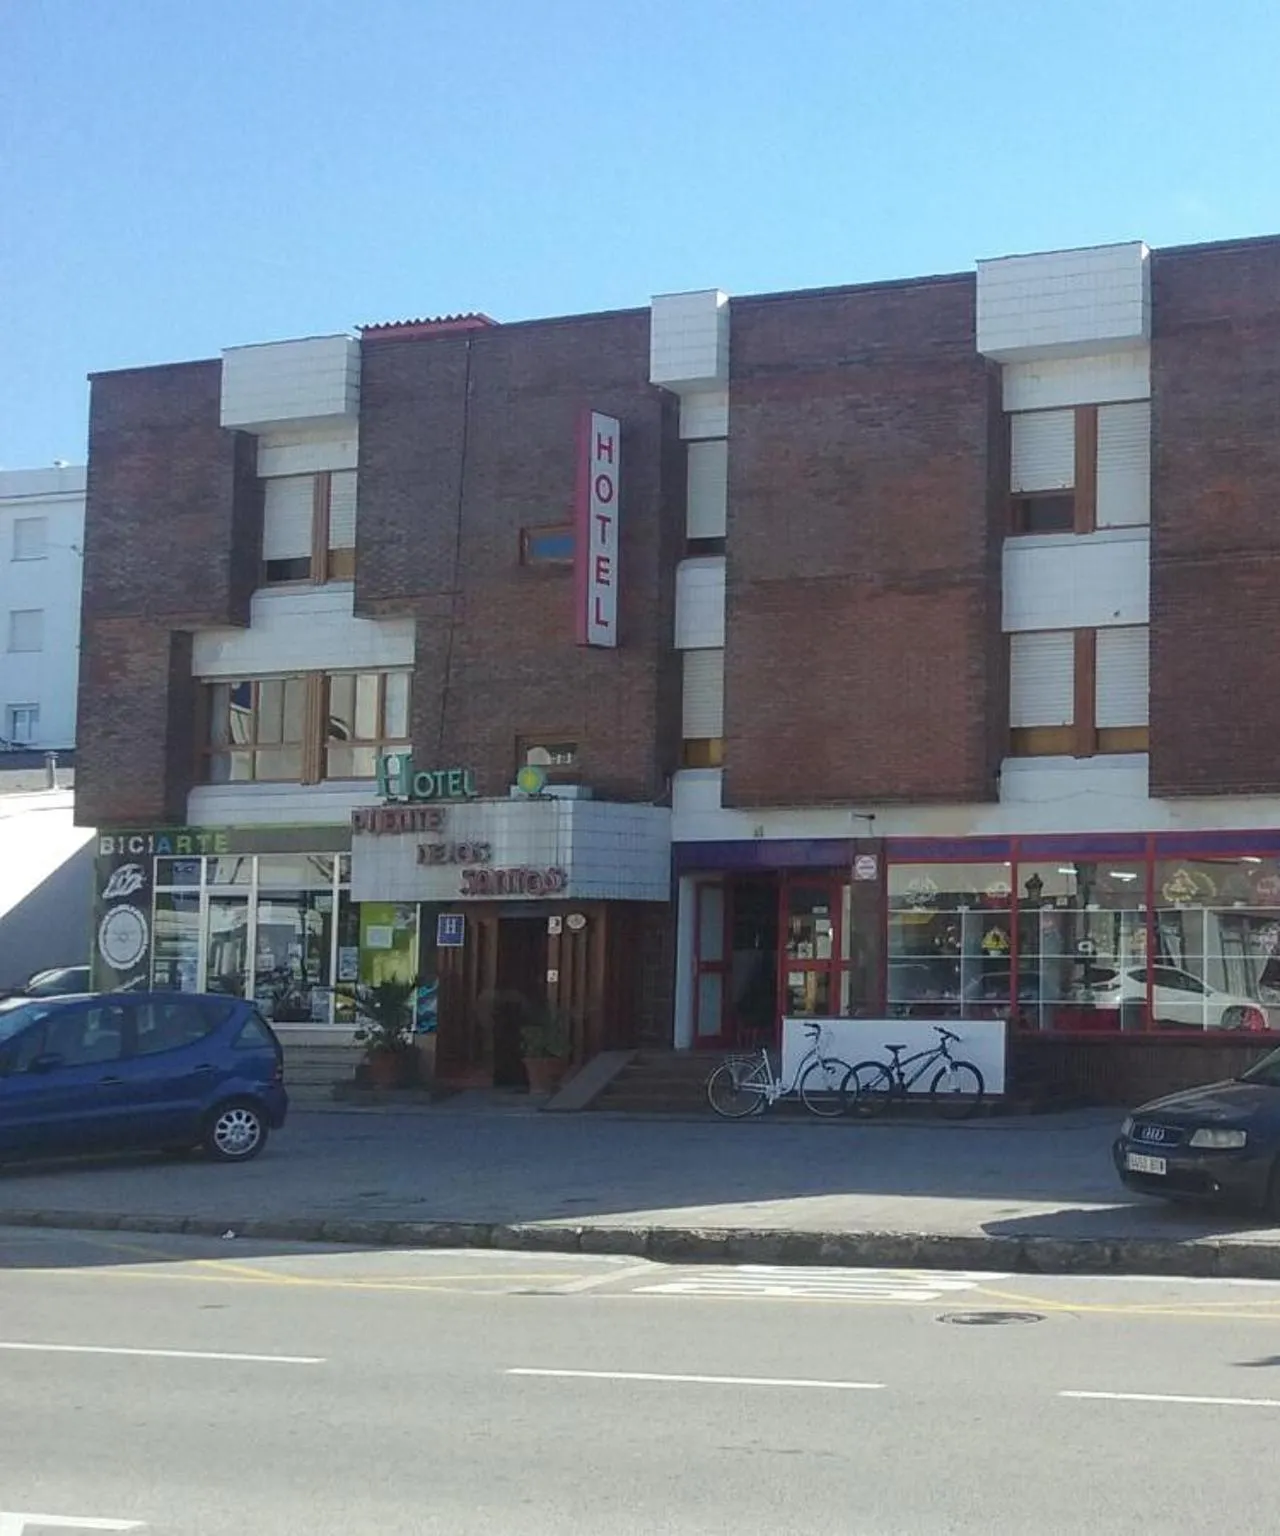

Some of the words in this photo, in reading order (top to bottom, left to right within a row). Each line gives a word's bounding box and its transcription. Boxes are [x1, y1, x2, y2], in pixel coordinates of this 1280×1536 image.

[595, 431, 613, 627] HOTEL
[375, 753, 478, 798] HOTEL
[100, 833, 228, 855] BICIARTE
[445, 917, 456, 934] H
